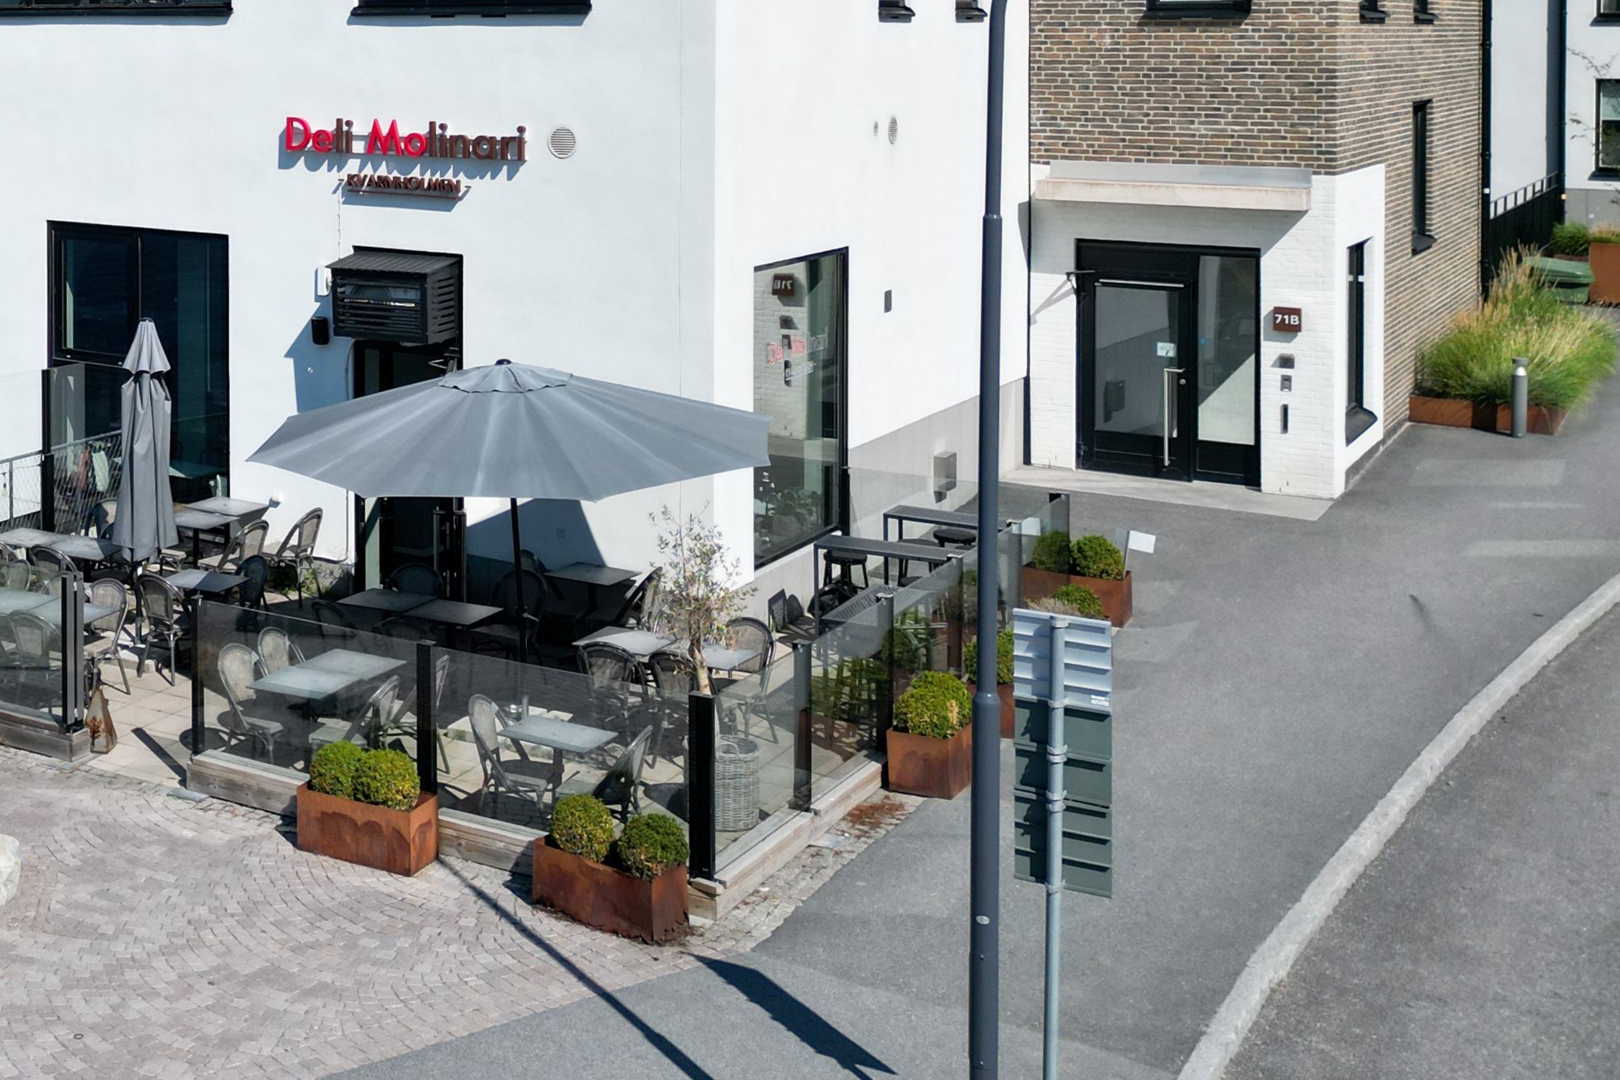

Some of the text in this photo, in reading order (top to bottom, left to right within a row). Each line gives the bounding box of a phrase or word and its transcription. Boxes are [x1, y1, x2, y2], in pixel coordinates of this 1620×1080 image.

[285, 116, 526, 161] Deli Molinari
[346, 173, 462, 193] KVARNHOLMEN
[1274, 313, 1300, 326] 71B
